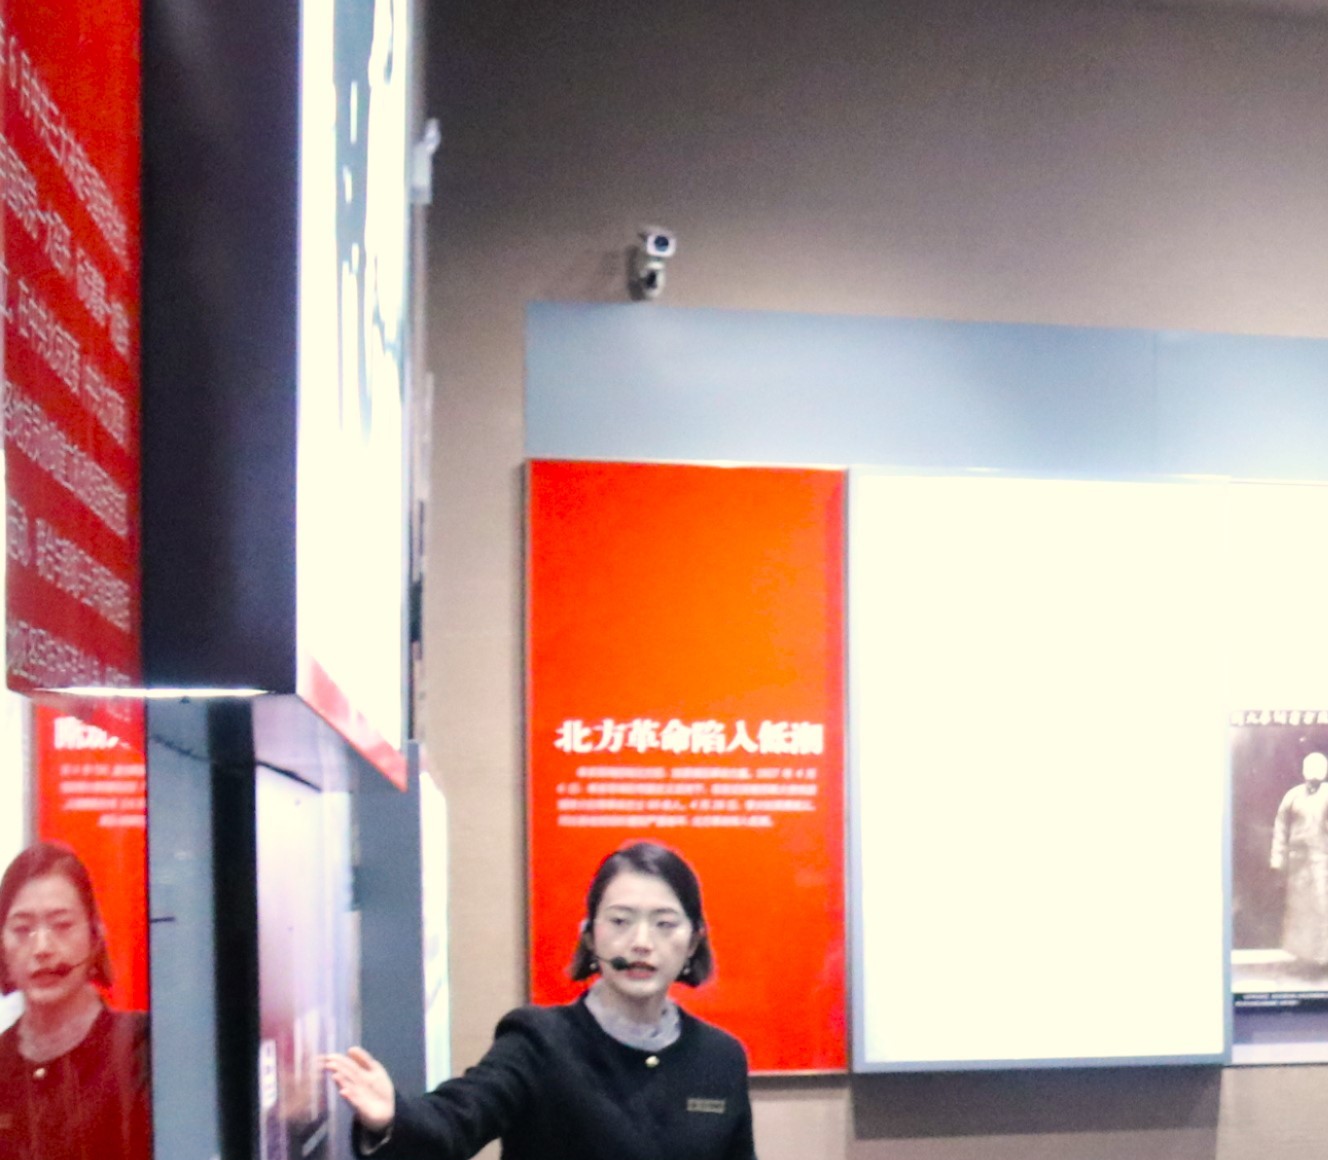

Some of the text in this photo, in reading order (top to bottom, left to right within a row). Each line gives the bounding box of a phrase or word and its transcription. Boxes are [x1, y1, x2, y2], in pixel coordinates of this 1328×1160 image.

[554, 718, 824, 754] 北方革命陷入低潮
